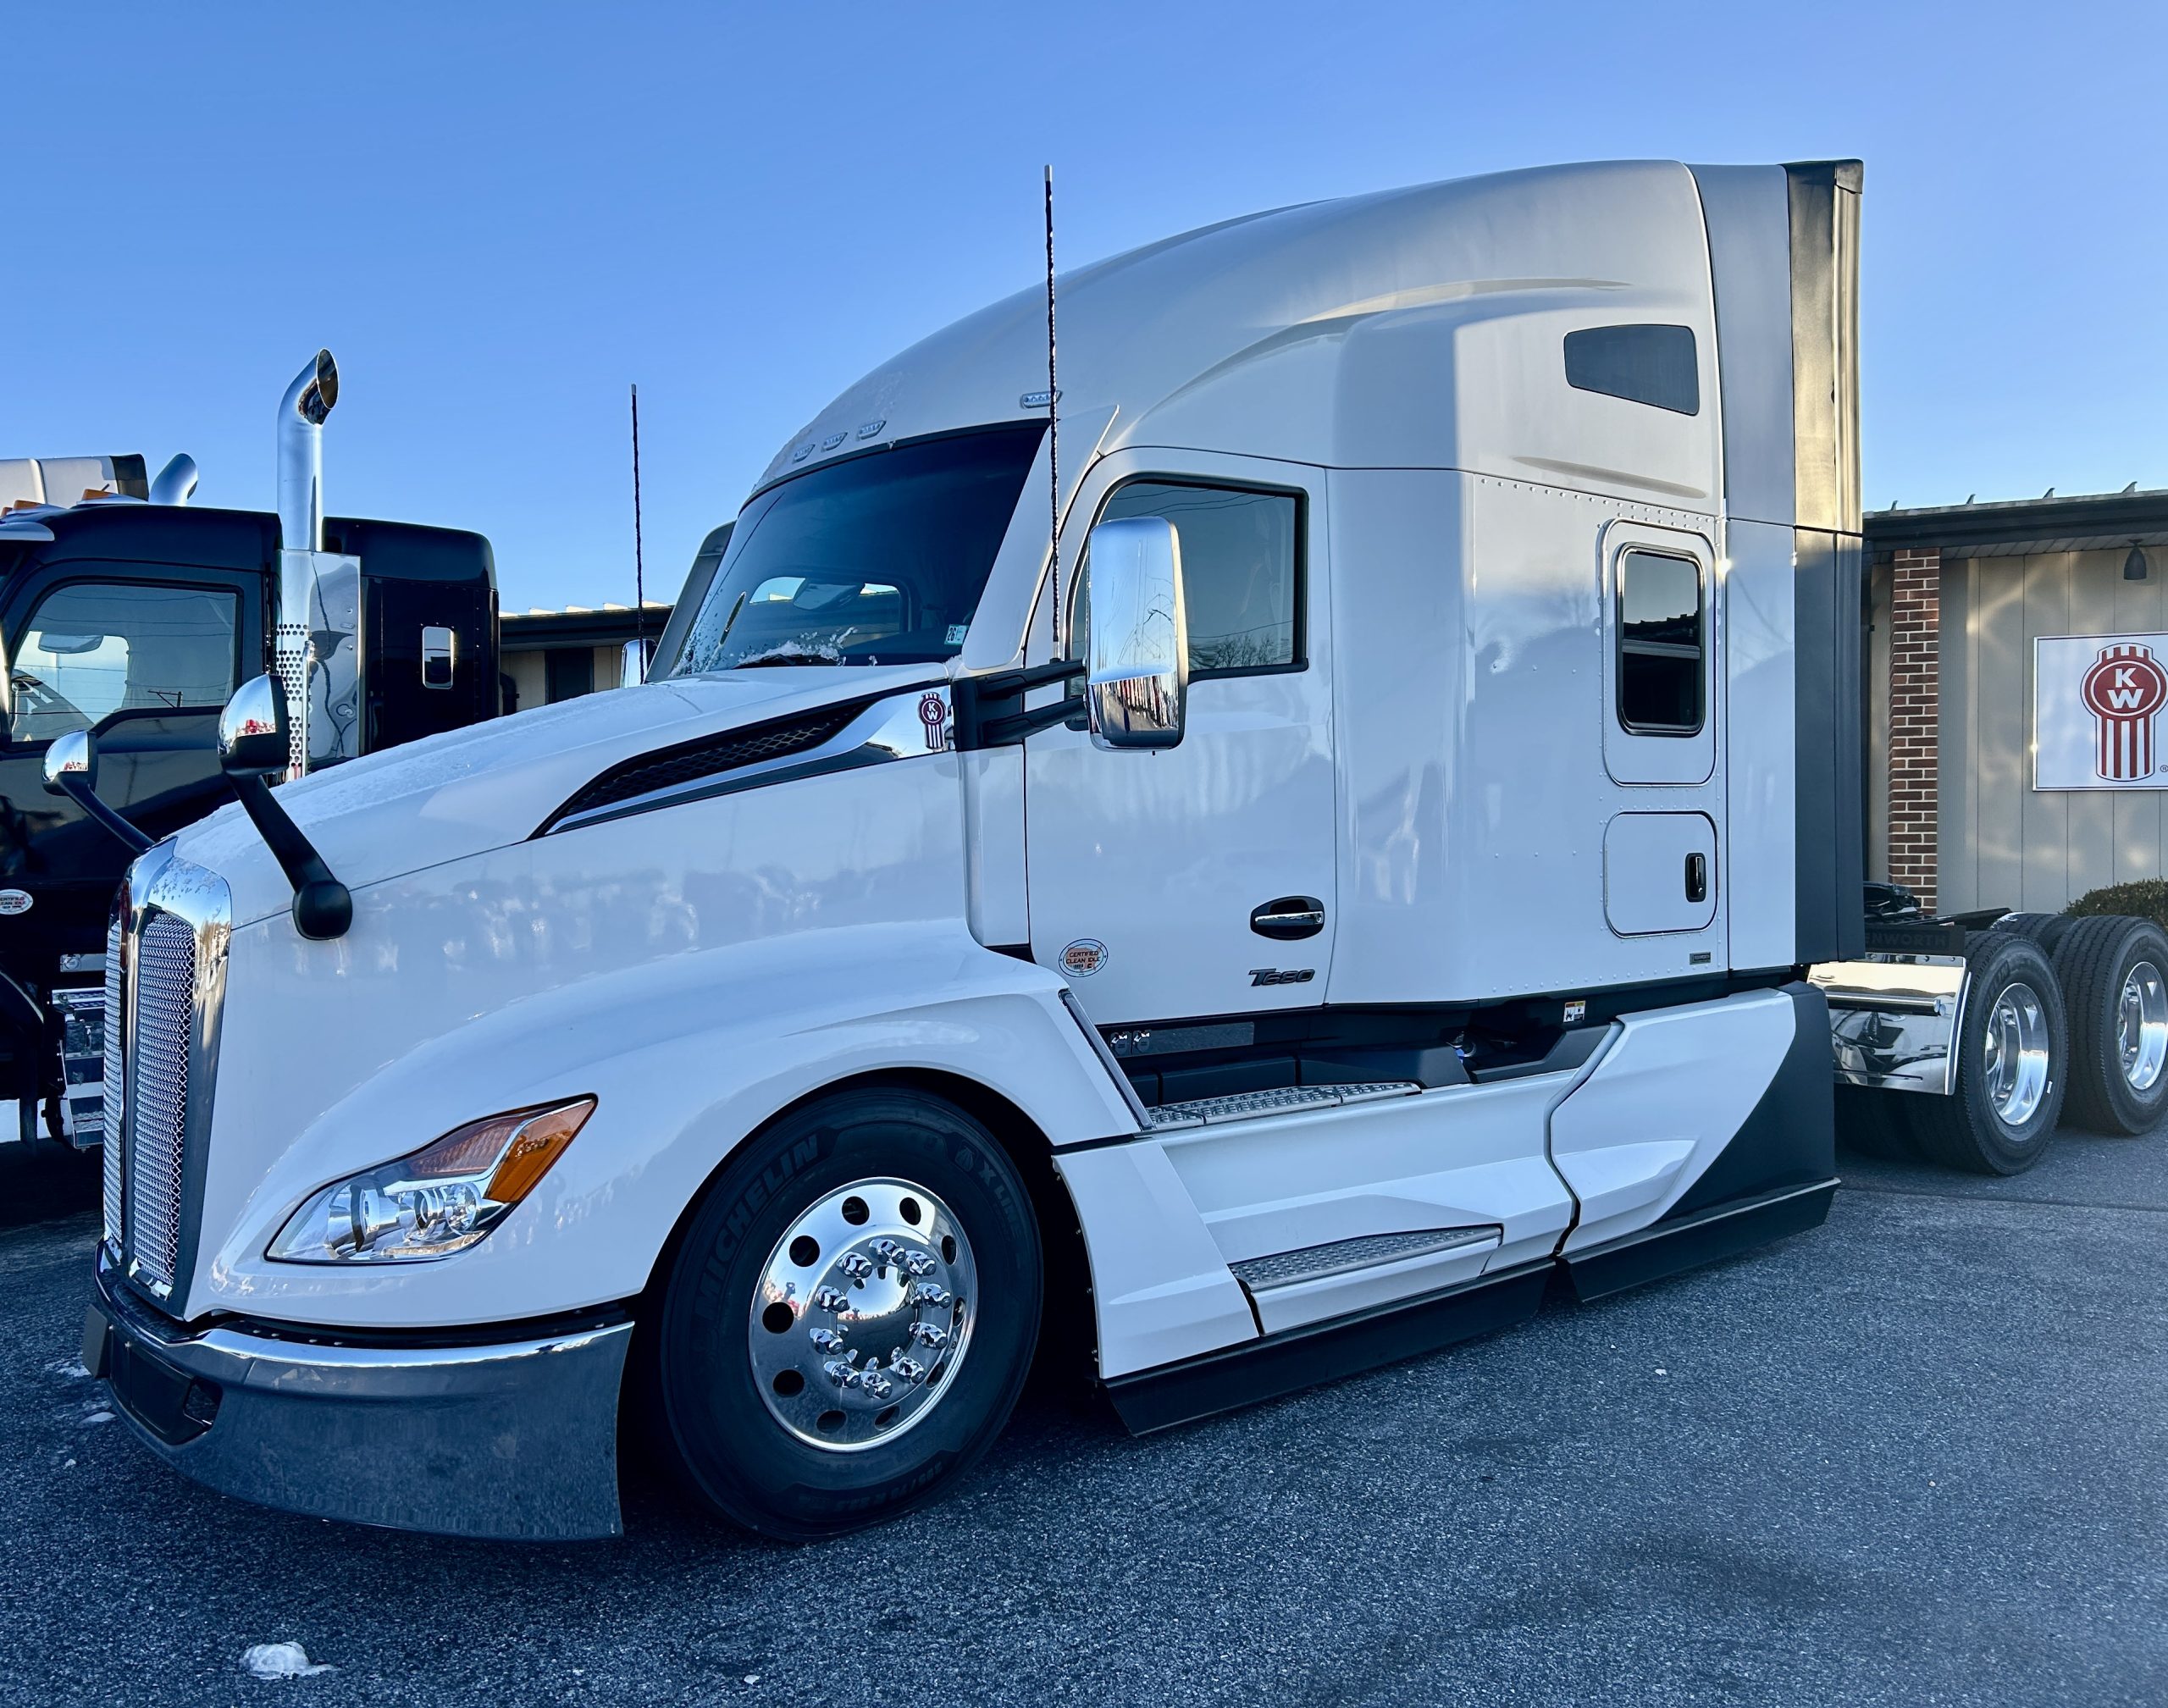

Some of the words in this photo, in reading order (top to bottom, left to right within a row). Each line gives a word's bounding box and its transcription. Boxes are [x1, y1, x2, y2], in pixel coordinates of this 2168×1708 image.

[948, 627, 957, 641] 26
[2115, 668, 2138, 688] K
[928, 703, 936, 711] K
[2107, 688, 2144, 709] W
[927, 711, 938, 720] W
[1248, 968, 1315, 987] T680
[694, 1133, 819, 1321] MICHELIN
